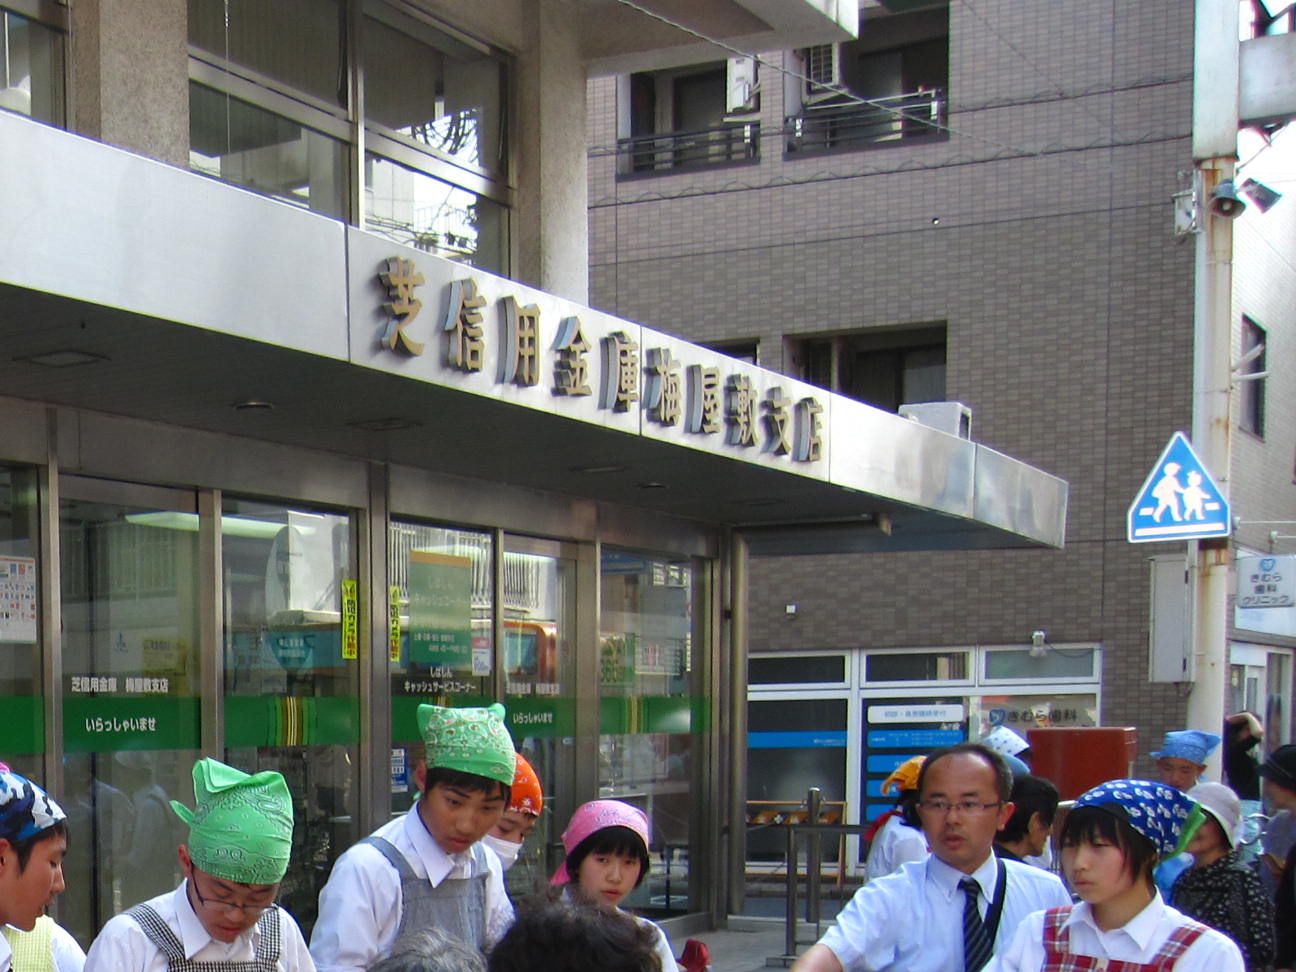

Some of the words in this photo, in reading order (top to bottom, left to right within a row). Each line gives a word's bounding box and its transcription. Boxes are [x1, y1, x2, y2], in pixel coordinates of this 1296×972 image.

[85, 717, 157, 732] いらっしゃいませ
